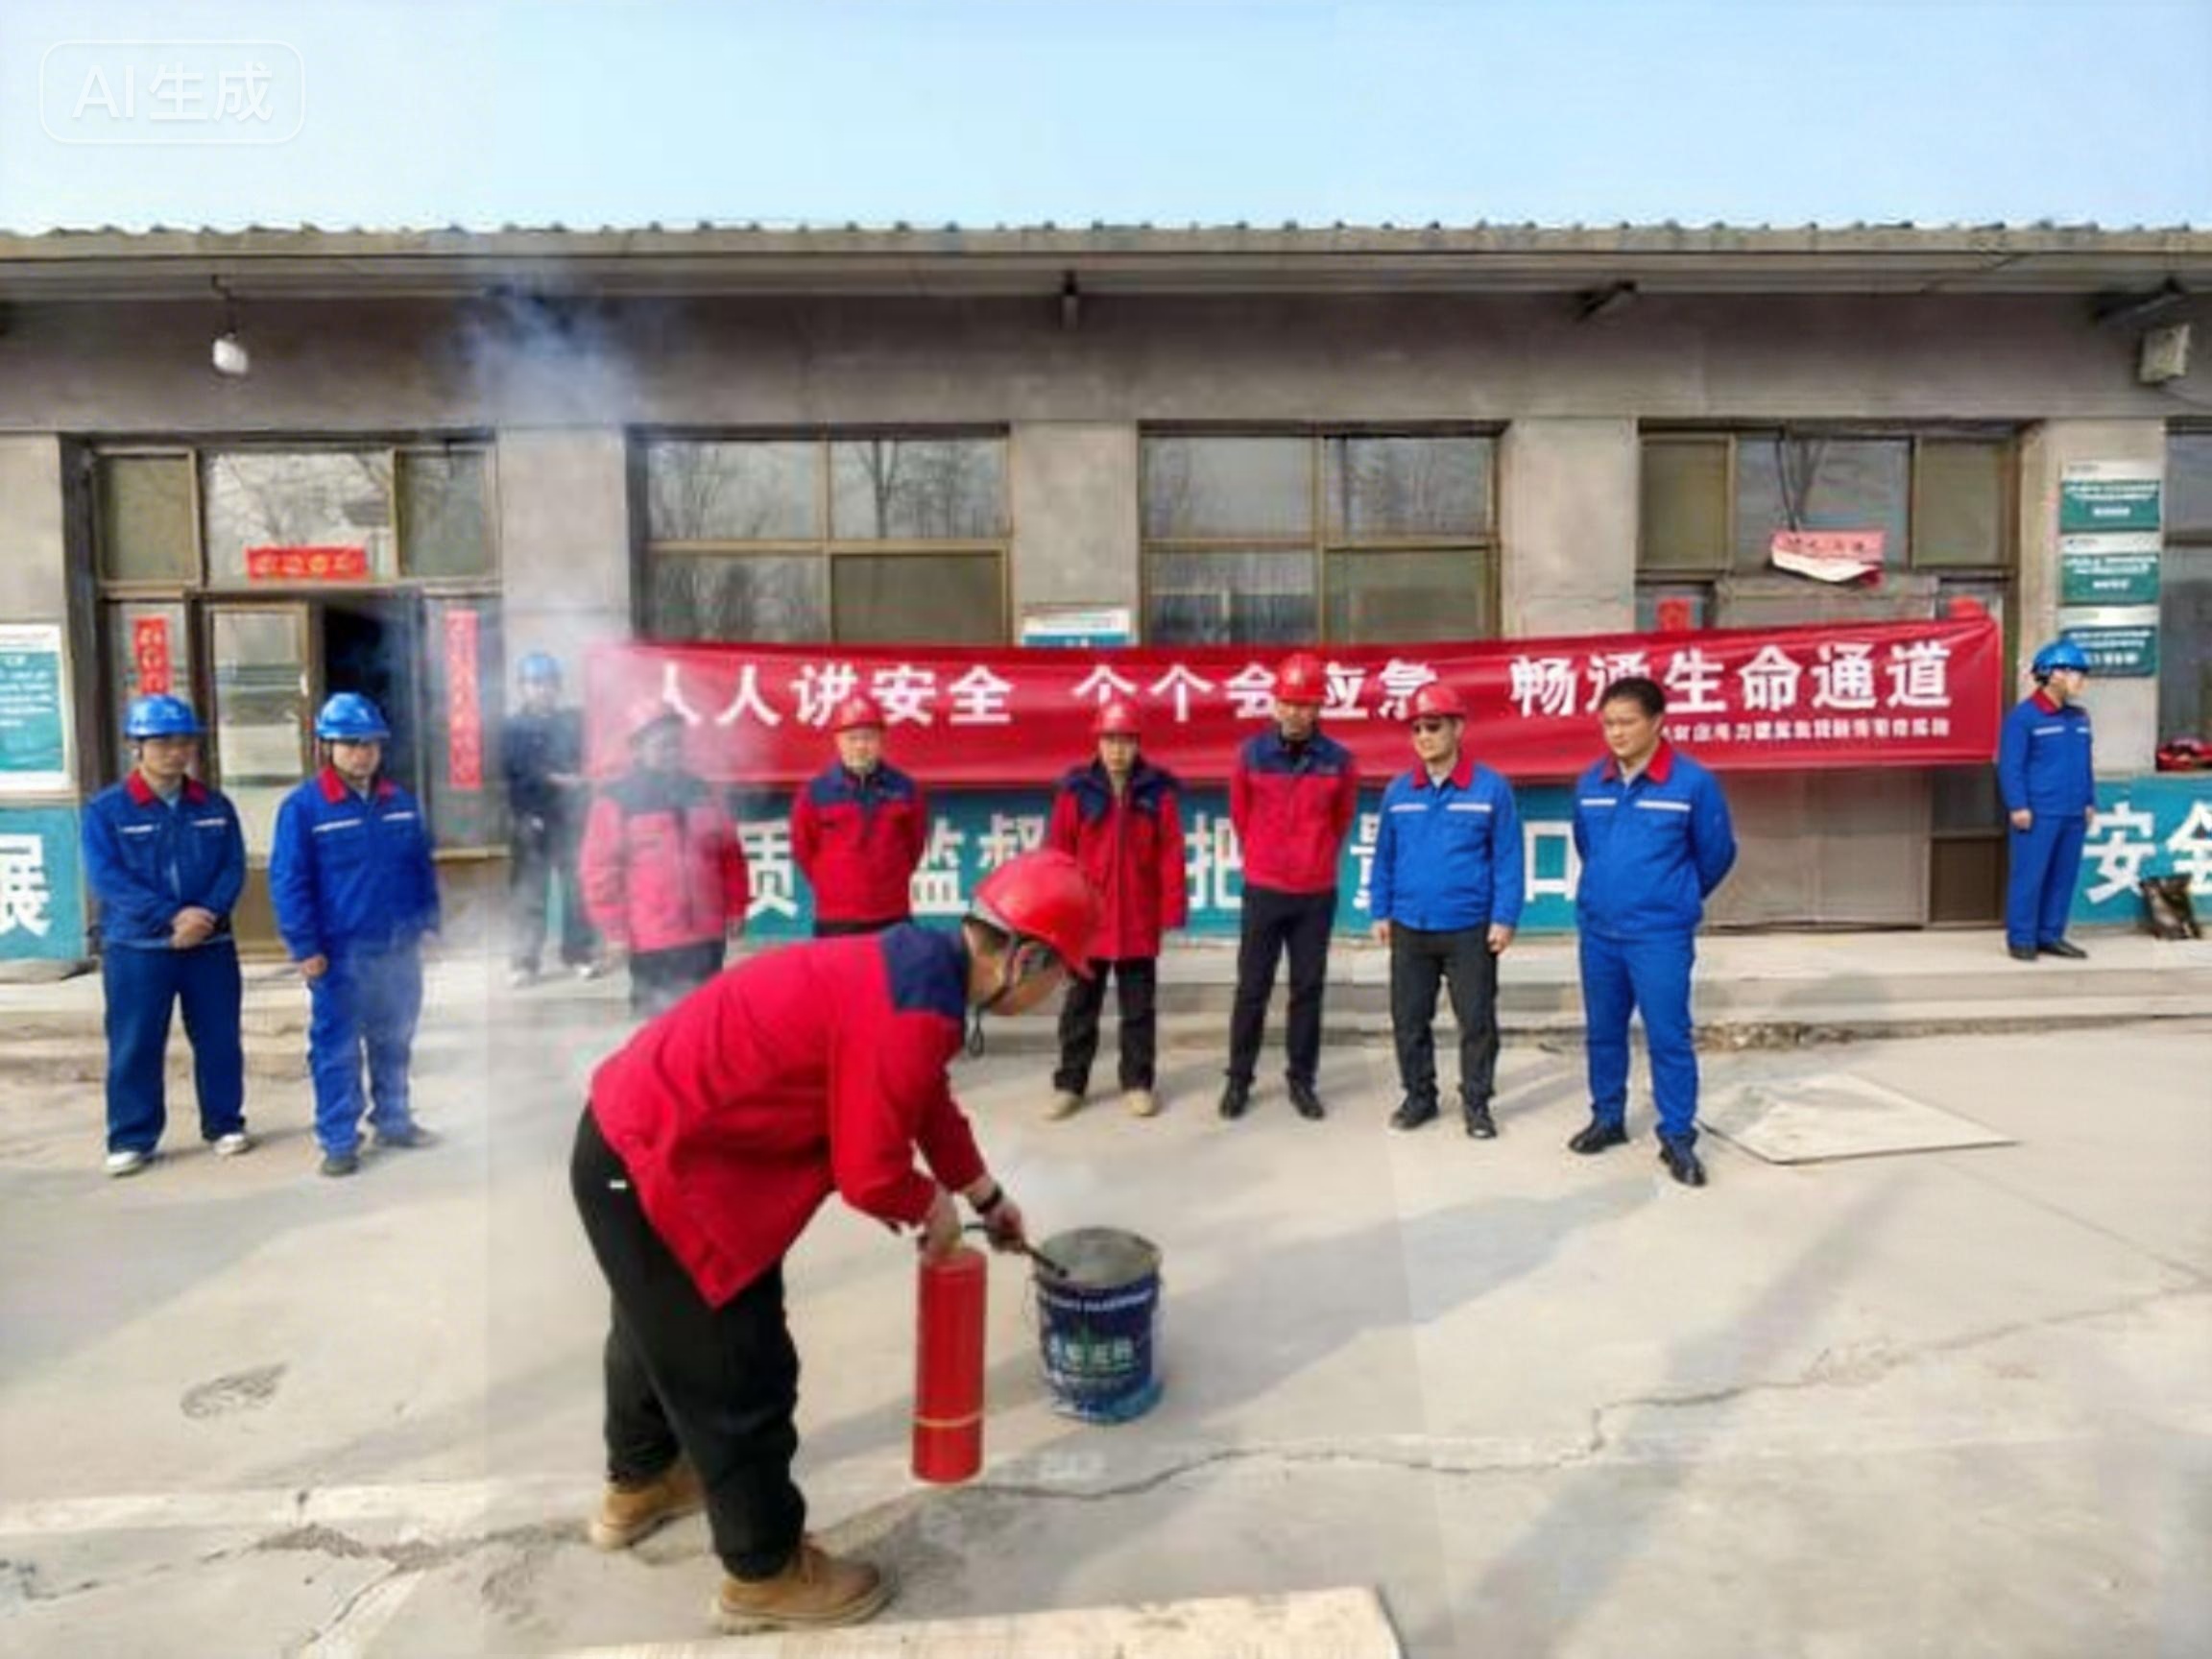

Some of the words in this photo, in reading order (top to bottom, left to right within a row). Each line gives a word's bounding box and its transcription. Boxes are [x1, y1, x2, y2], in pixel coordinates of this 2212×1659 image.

[626, 661, 1014, 727] 人人讲安全
[1510, 640, 1952, 716] 畅通生命通道
[2082, 800, 2212, 905] 安全
